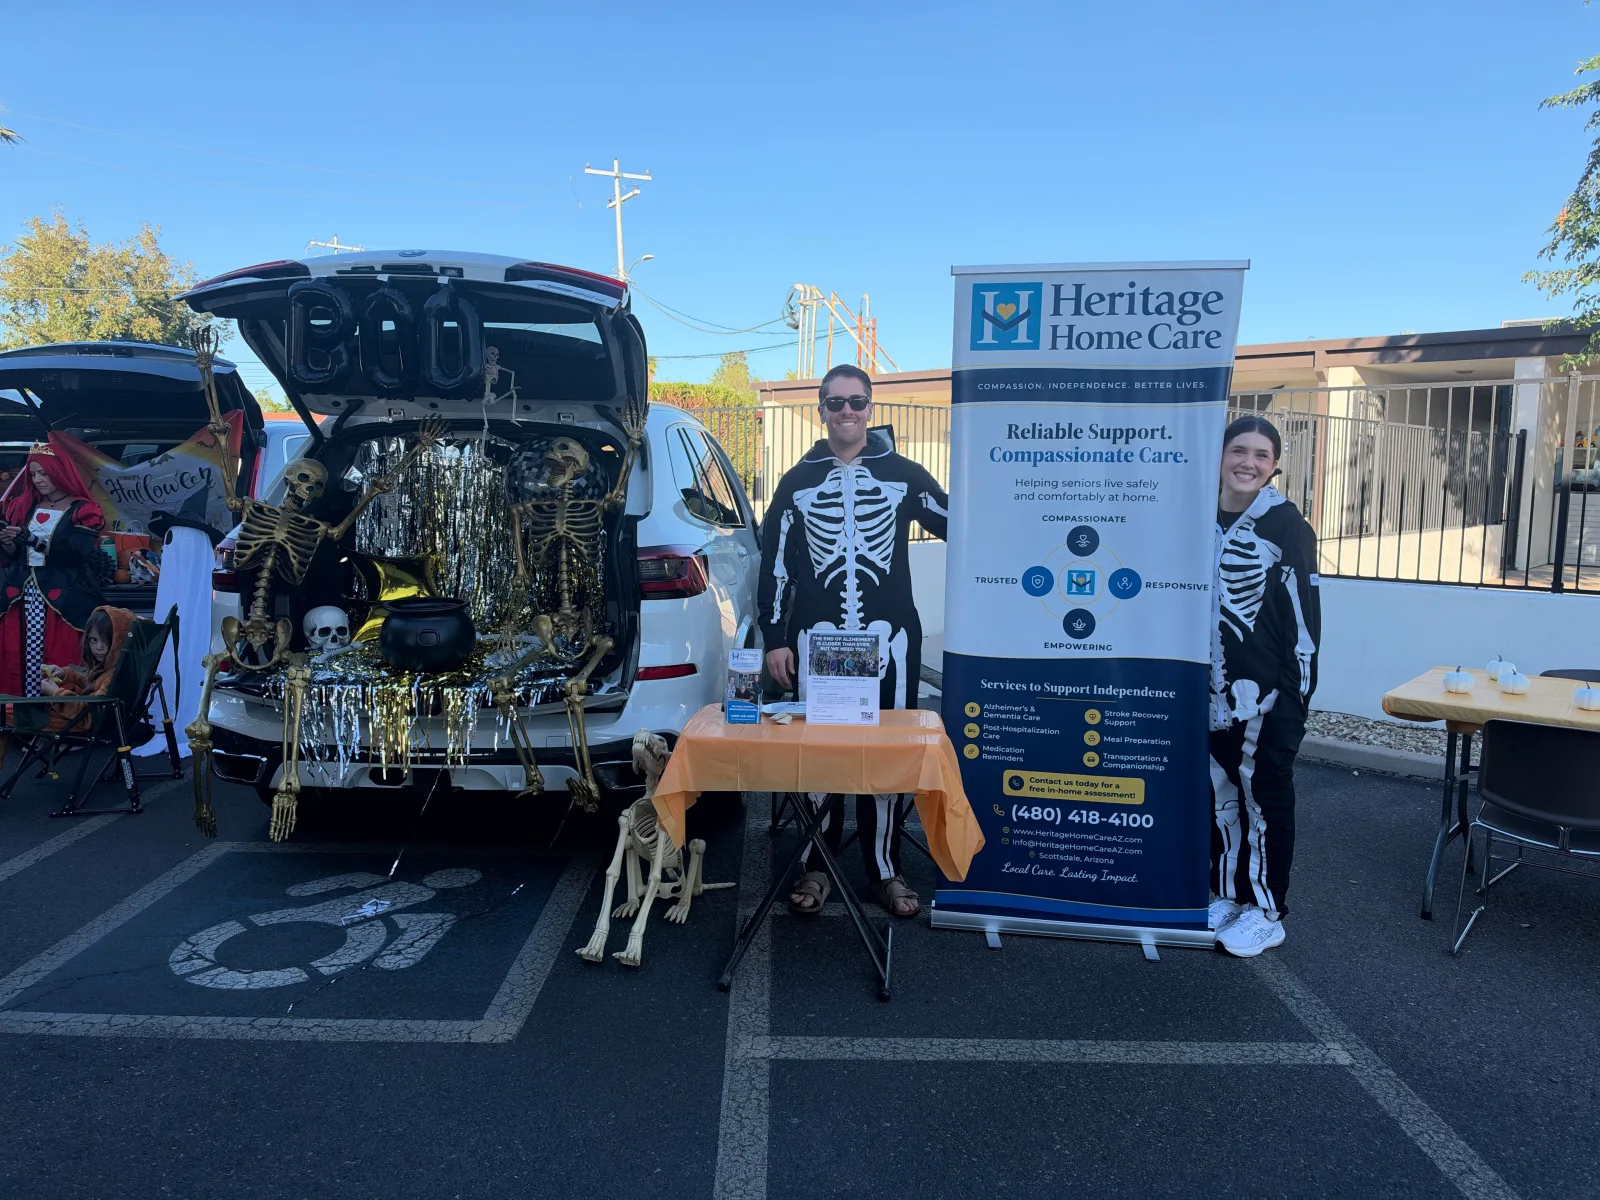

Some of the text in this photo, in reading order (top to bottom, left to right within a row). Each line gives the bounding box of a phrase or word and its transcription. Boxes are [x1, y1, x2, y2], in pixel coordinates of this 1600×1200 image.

[1050, 281, 1224, 326] Heritage
[285, 279, 484, 392] BOO
[1048, 323, 1222, 351] Home Care
[977, 381, 1208, 391] COMPASSION. INDEPENDENCE. BETTER LIVES.
[1006, 422, 1173, 445] Reliable Support.
[989, 446, 1189, 467] Compassionate Care.
[105, 467, 216, 505] Halloween
[1015, 478, 1159, 491] Helping seniors live safely
[1014, 491, 1159, 503] and comfortably at home.
[1042, 514, 1127, 523] COMPASSIONATE
[975, 576, 1018, 585] TRUSTED
[1145, 581, 1209, 591] RESPONSIVE
[1044, 642, 1113, 652] EMPOWERING
[981, 678, 1176, 699] Services to Support Independence
[983, 703, 1028, 712] Alzheimer's
[983, 712, 1021, 720] Dementia
[1104, 710, 1169, 721] Stroke Recovery
[1104, 719, 1137, 727] Support
[983, 724, 1060, 735] Post-Hospitalization
[982, 732, 1001, 740] Care
[1103, 735, 1171, 746] Meal Preparation
[982, 745, 1025, 754] Medication
[982, 753, 1024, 762] Reminders
[1103, 753, 1161, 762] Transportation
[1102, 761, 1165, 772] Companionship
[1029, 776, 1061, 785] Contact
[1075, 780, 1099, 789] today
[1101, 781, 1113, 789] for
[1029, 785, 1136, 799] free in-home assessment!
[1011, 804, 1154, 828] (480) 418-4100
[1012, 828, 1143, 844] www.HeritageHomeCareAZ.com
[1012, 838, 1143, 855] Info@HeritageHomeCareAZ.com
[1038, 852, 1114, 865] Scottsdale, Arizona
[1001, 861, 1139, 884] Local Care. Lasting Impact.
